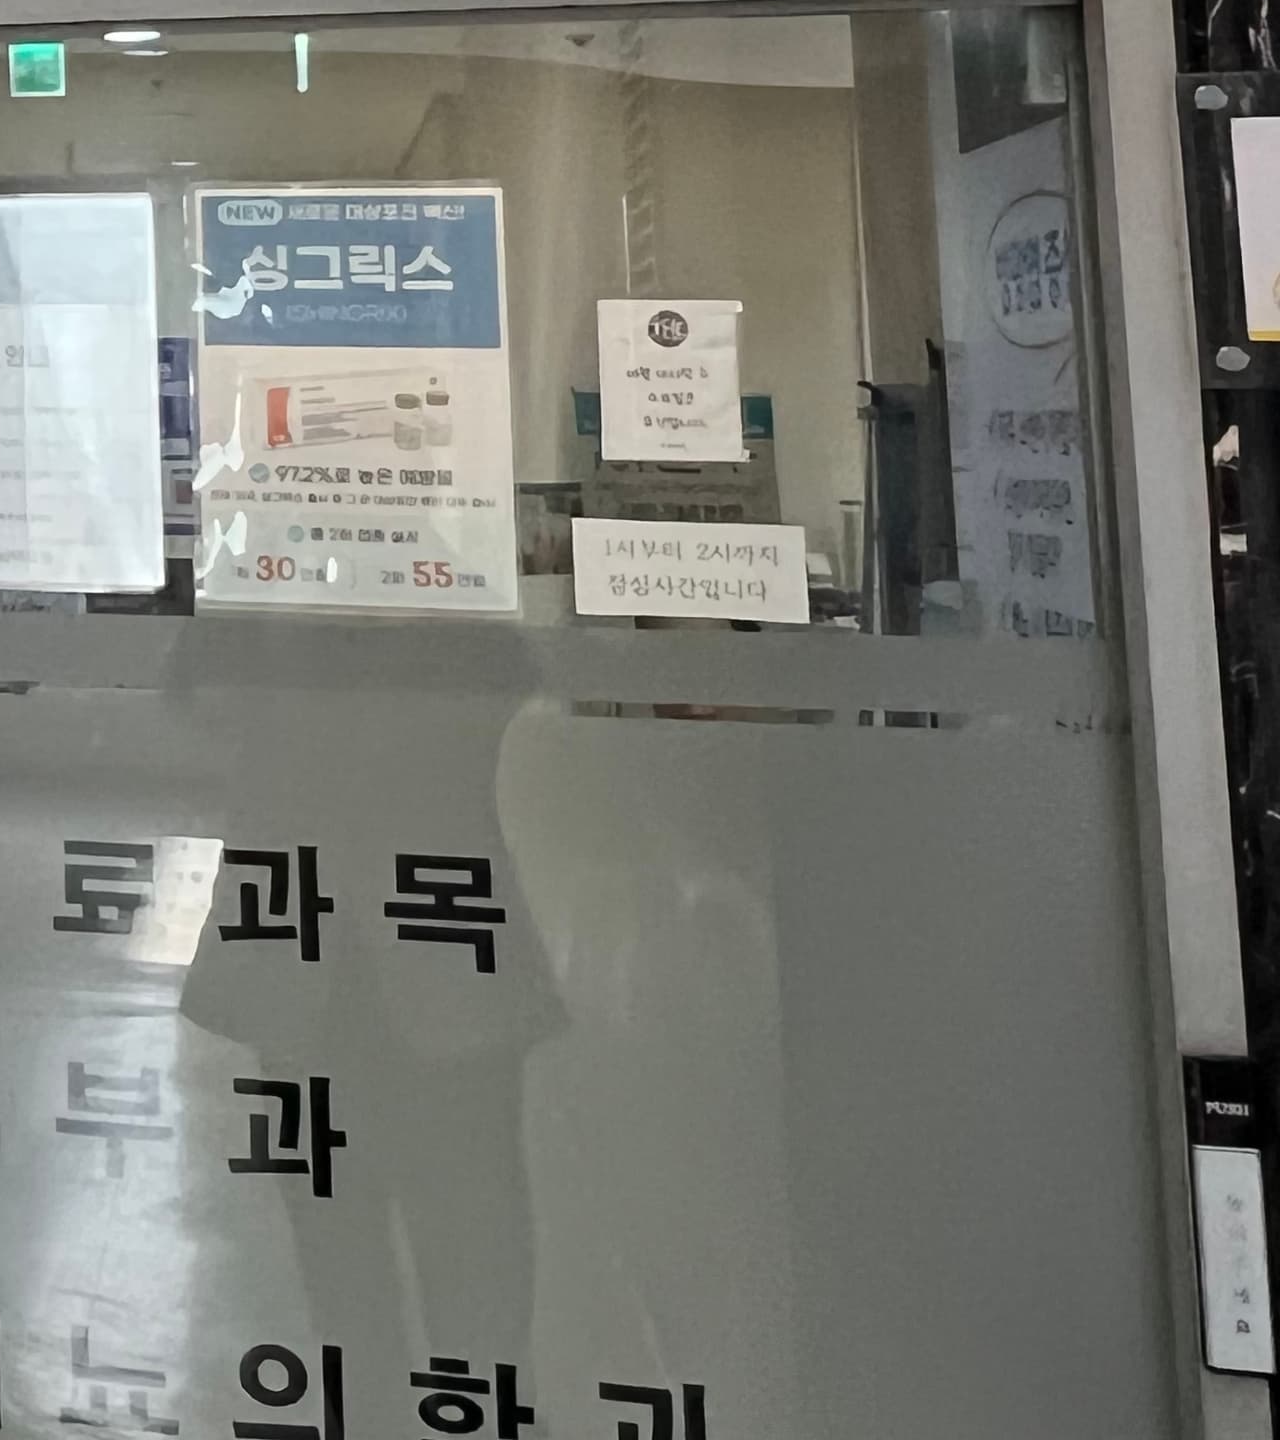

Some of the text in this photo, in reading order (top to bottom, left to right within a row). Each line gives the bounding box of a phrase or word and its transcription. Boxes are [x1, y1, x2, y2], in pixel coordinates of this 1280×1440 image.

[226, 205, 275, 219] NEW
[242, 245, 454, 292] 싱그릭스
[696, 541, 779, 567] 2시까지
[608, 573, 768, 603] 점심시간입니다
